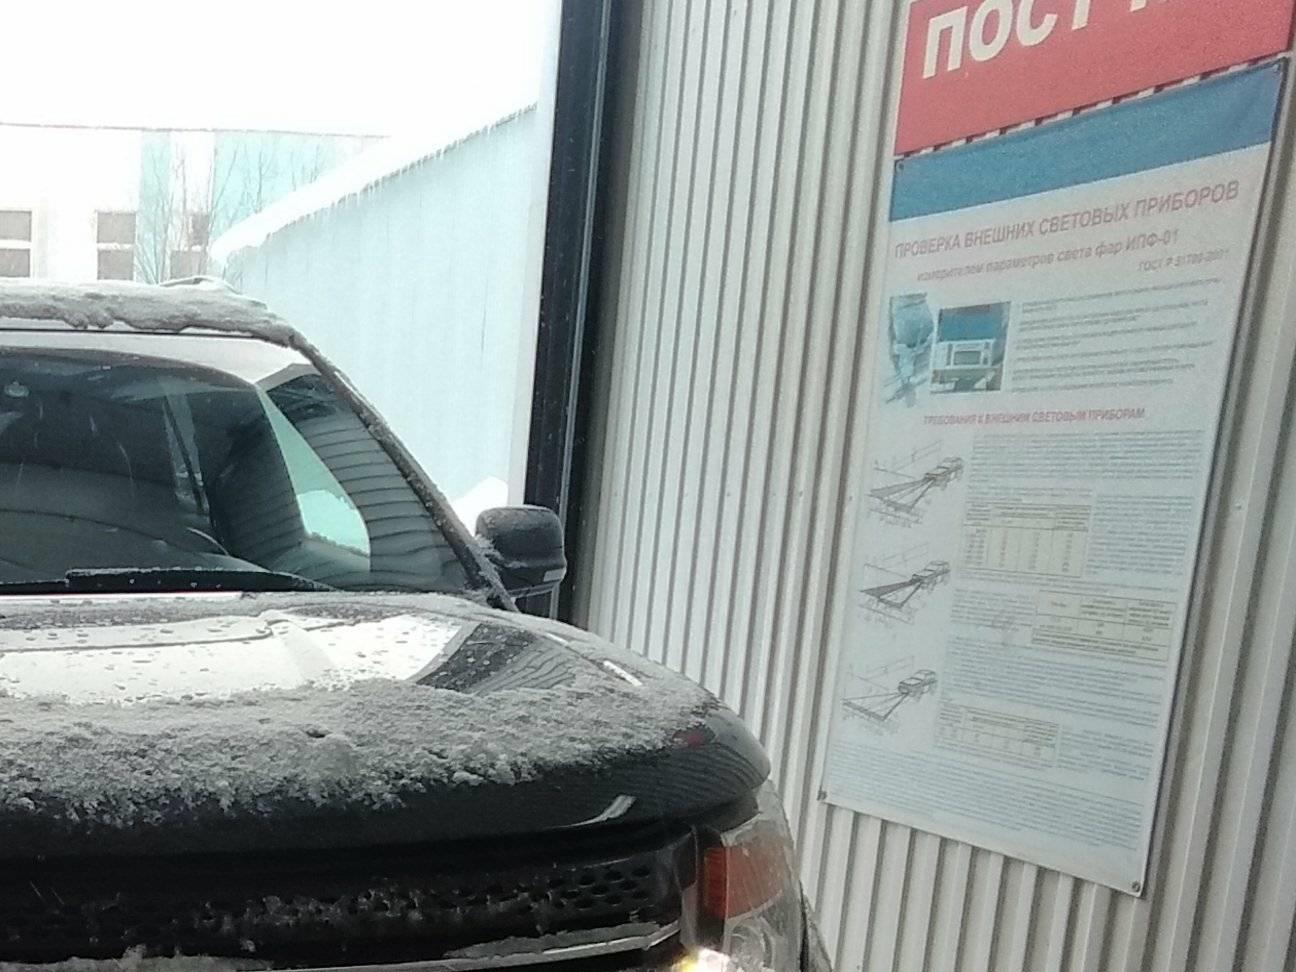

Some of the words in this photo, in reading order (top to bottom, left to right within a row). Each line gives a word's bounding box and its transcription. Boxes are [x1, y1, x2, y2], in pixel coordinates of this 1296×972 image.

[895, 234, 961, 258] ПРОВЕРКА
[964, 220, 1036, 248] ВНЕШНИХ
[1039, 202, 1130, 235] СВЕТОВЫХ
[1134, 180, 1240, 217] ПРИБОРОВ
[1095, 240, 1122, 259] фар
[1126, 228, 1180, 250] ИПФ-01
